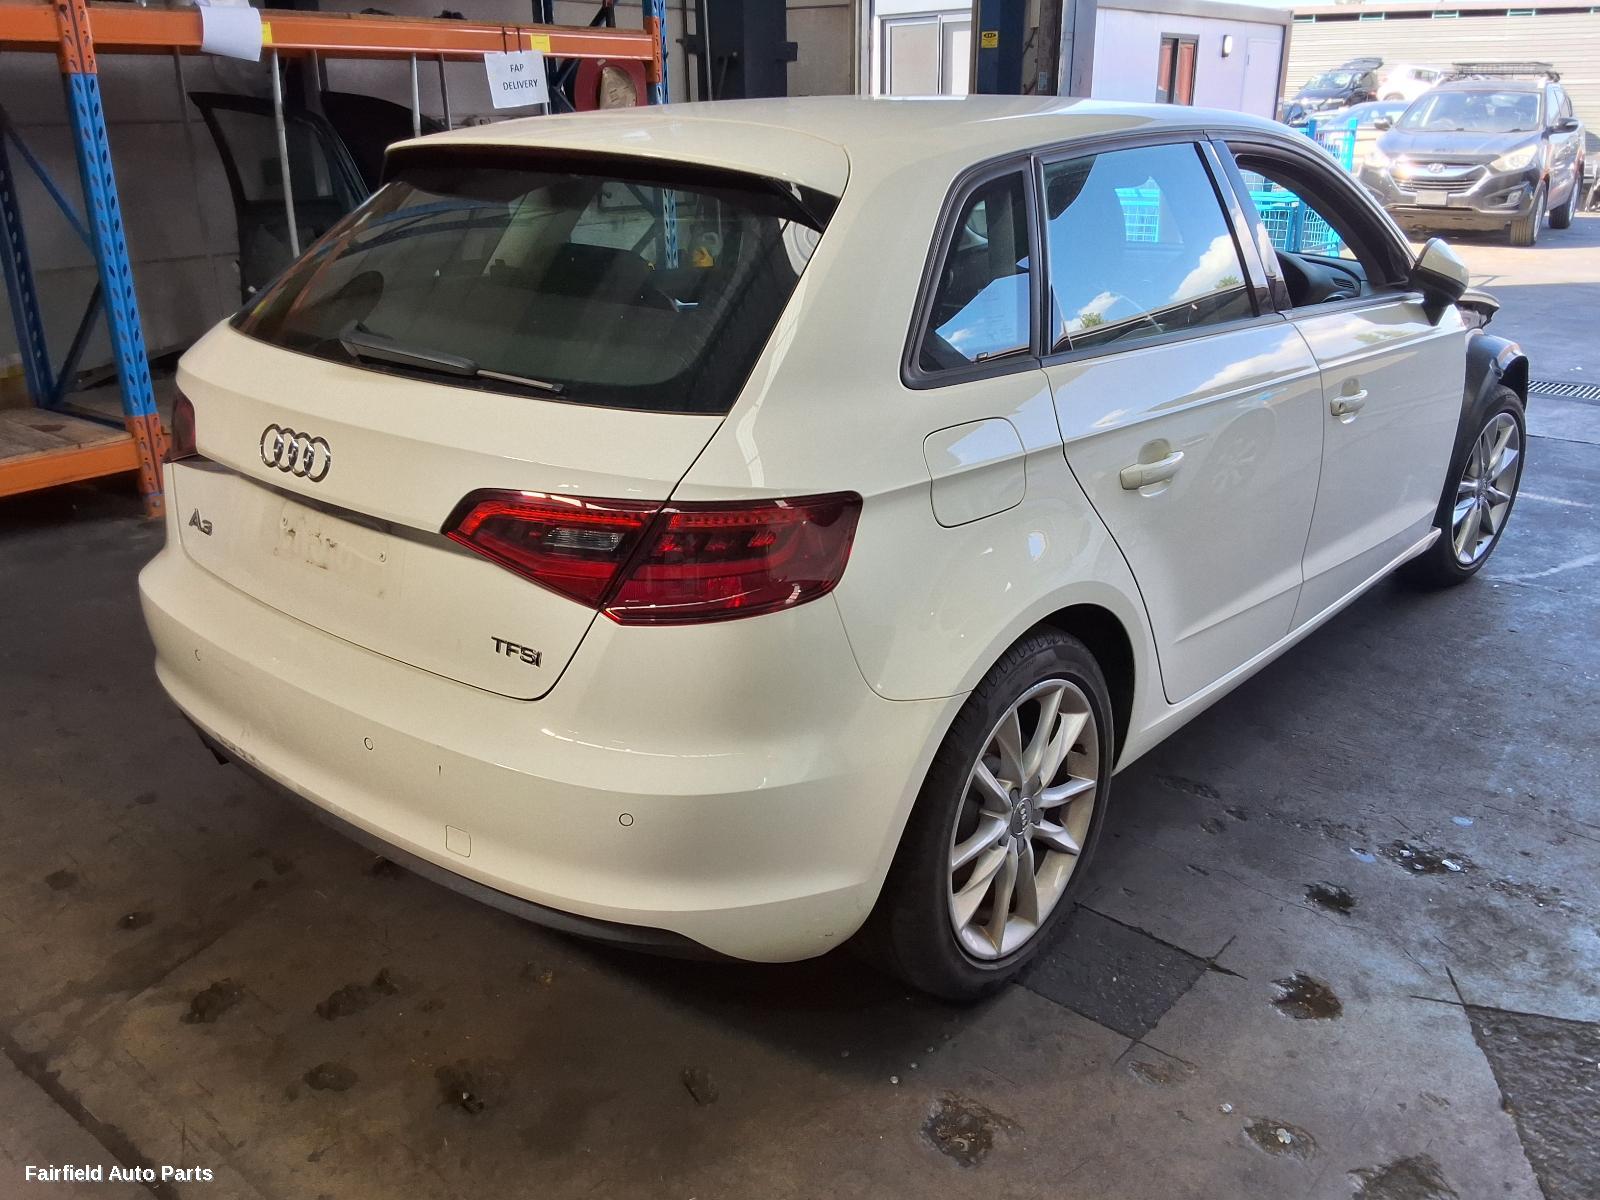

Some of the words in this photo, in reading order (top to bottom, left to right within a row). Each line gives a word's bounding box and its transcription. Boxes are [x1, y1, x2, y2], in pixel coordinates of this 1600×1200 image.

[509, 63, 525, 73] FAP
[502, 79, 539, 91] DELIVERY
[188, 507, 213, 537] A3
[490, 635, 543, 668] TFSI
